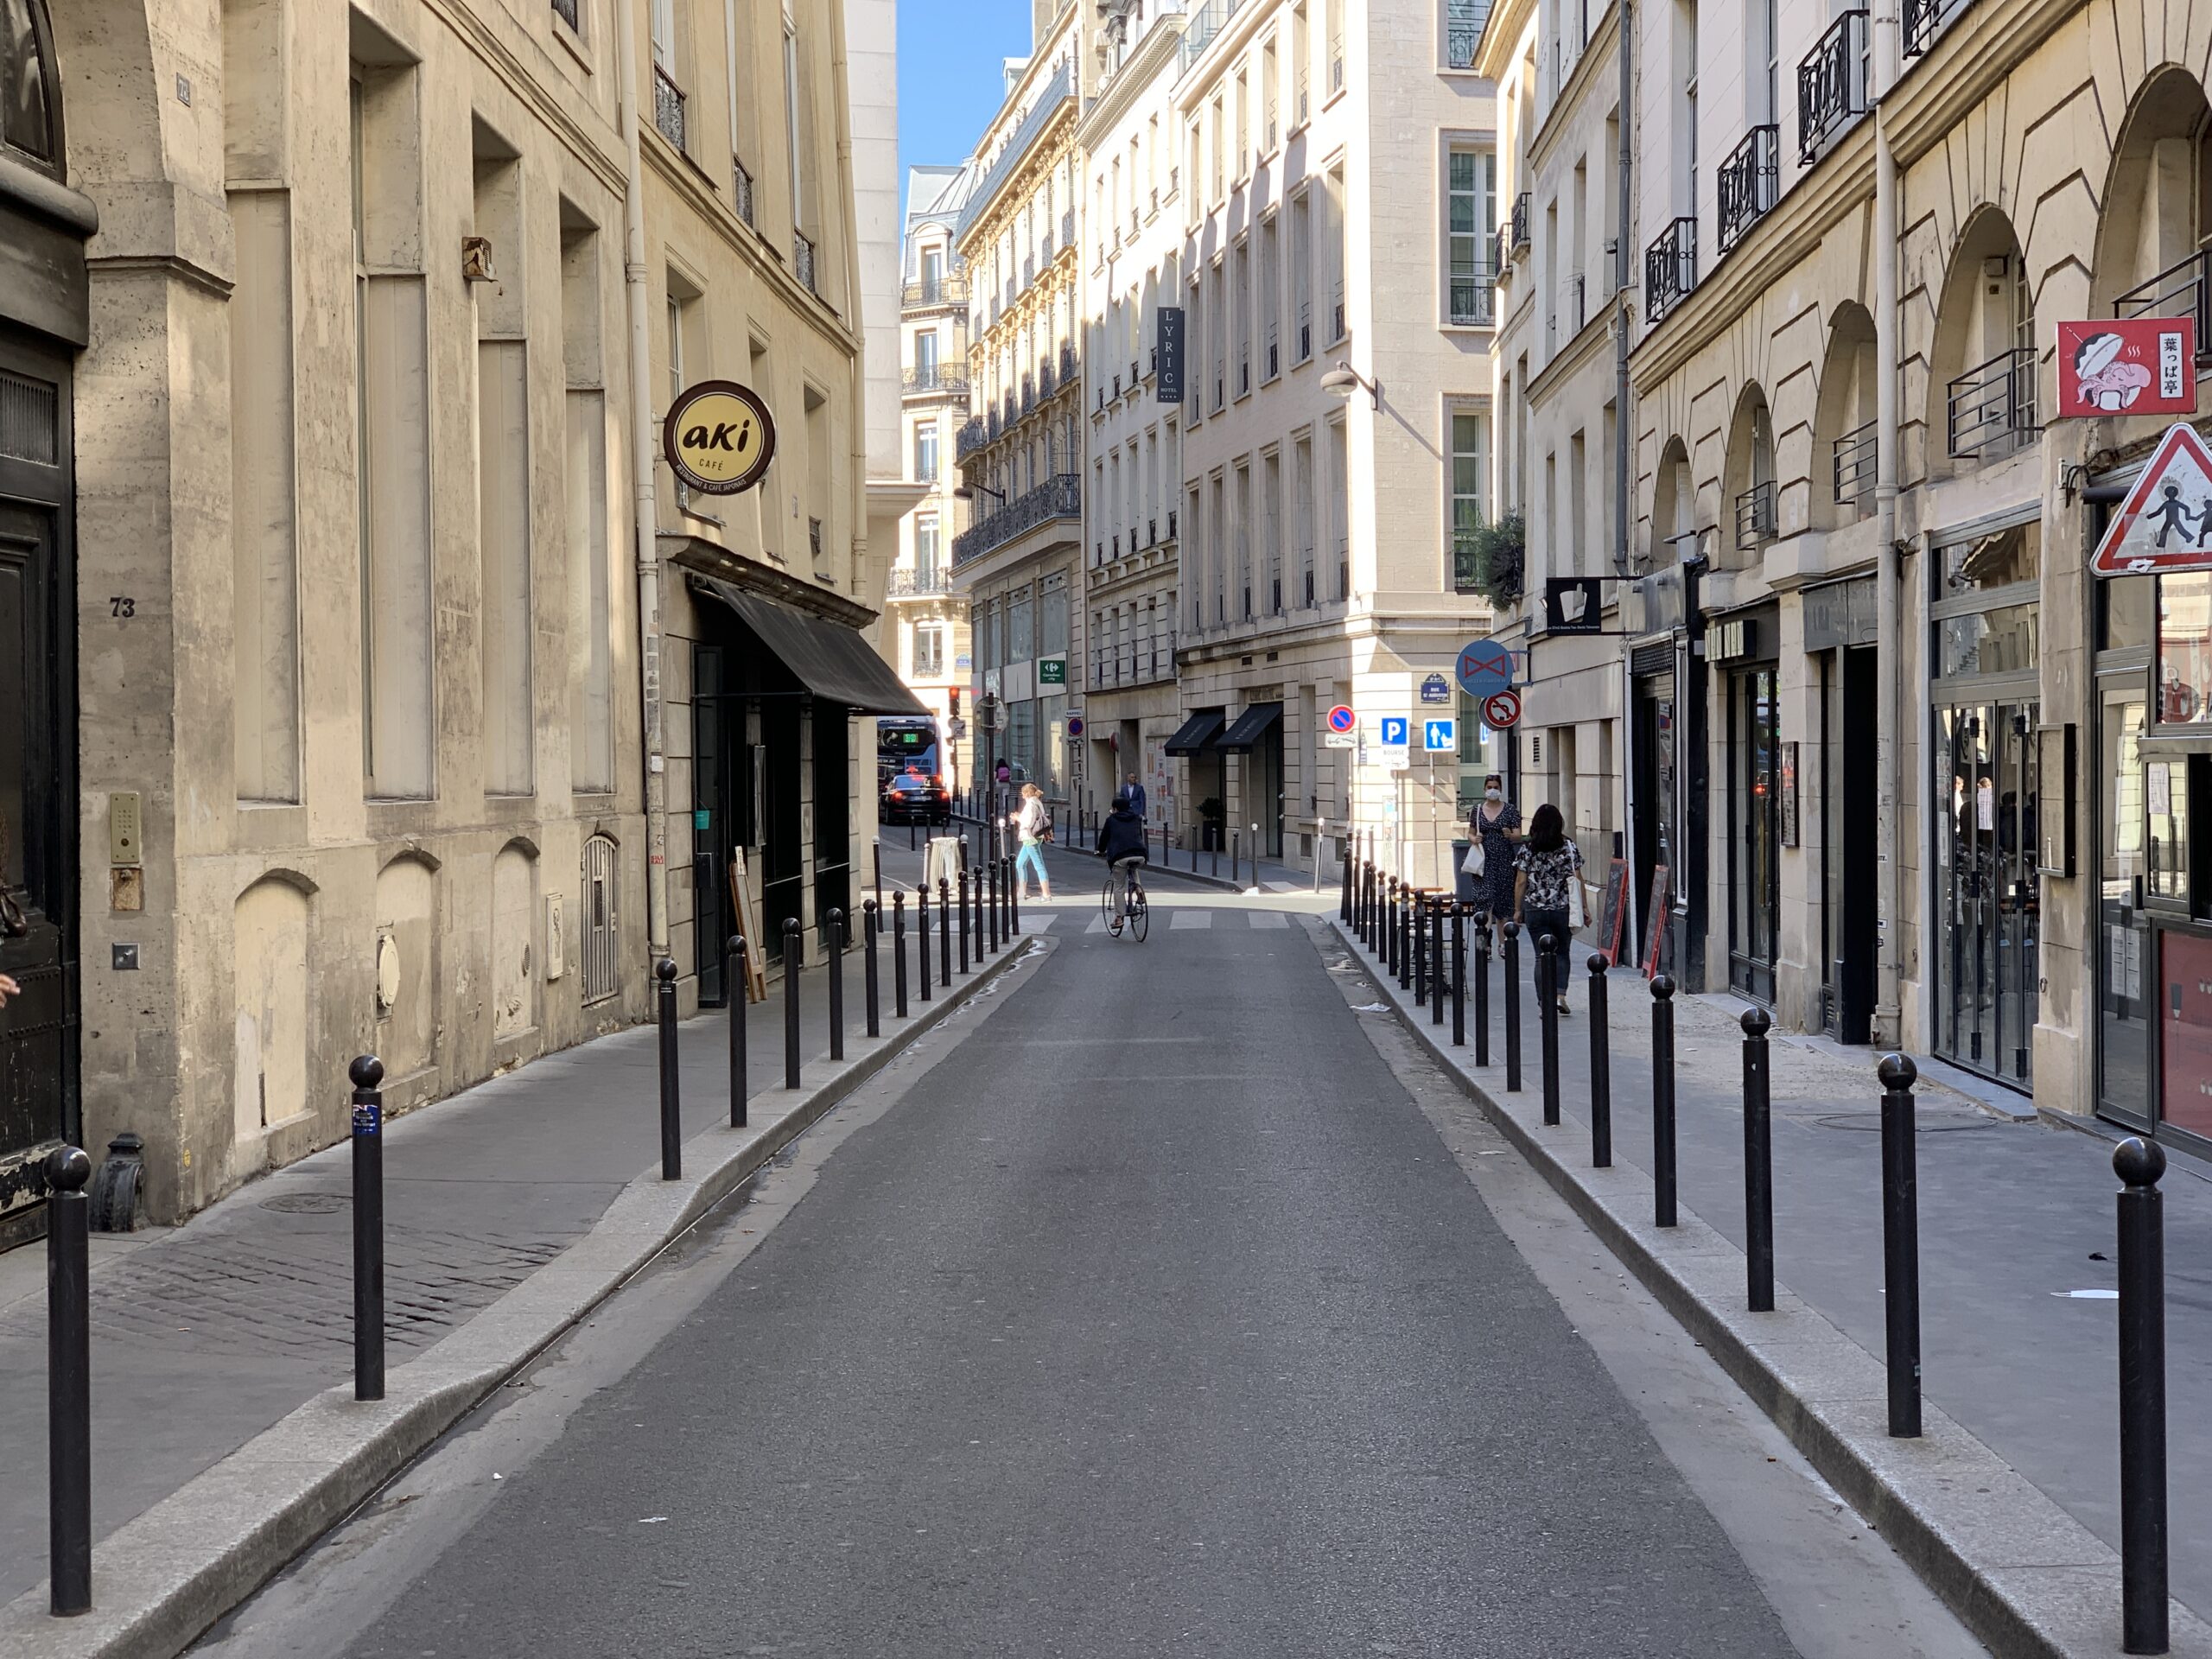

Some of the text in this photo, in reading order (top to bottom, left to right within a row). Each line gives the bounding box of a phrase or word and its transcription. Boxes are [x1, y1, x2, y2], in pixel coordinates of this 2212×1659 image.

[1164, 310, 1174, 384] LYRIC
[2164, 337, 2178, 394] 葉っぱ亭
[683, 419, 749, 452] aki
[676, 464, 702, 488] RESTAURANT
[709, 483, 722, 492] CAFÉ
[722, 479, 747, 492] JAPONAIS
[699, 458, 724, 471] CAFÉ
[110, 597, 135, 618] 73
[1388, 721, 1401, 741] P
